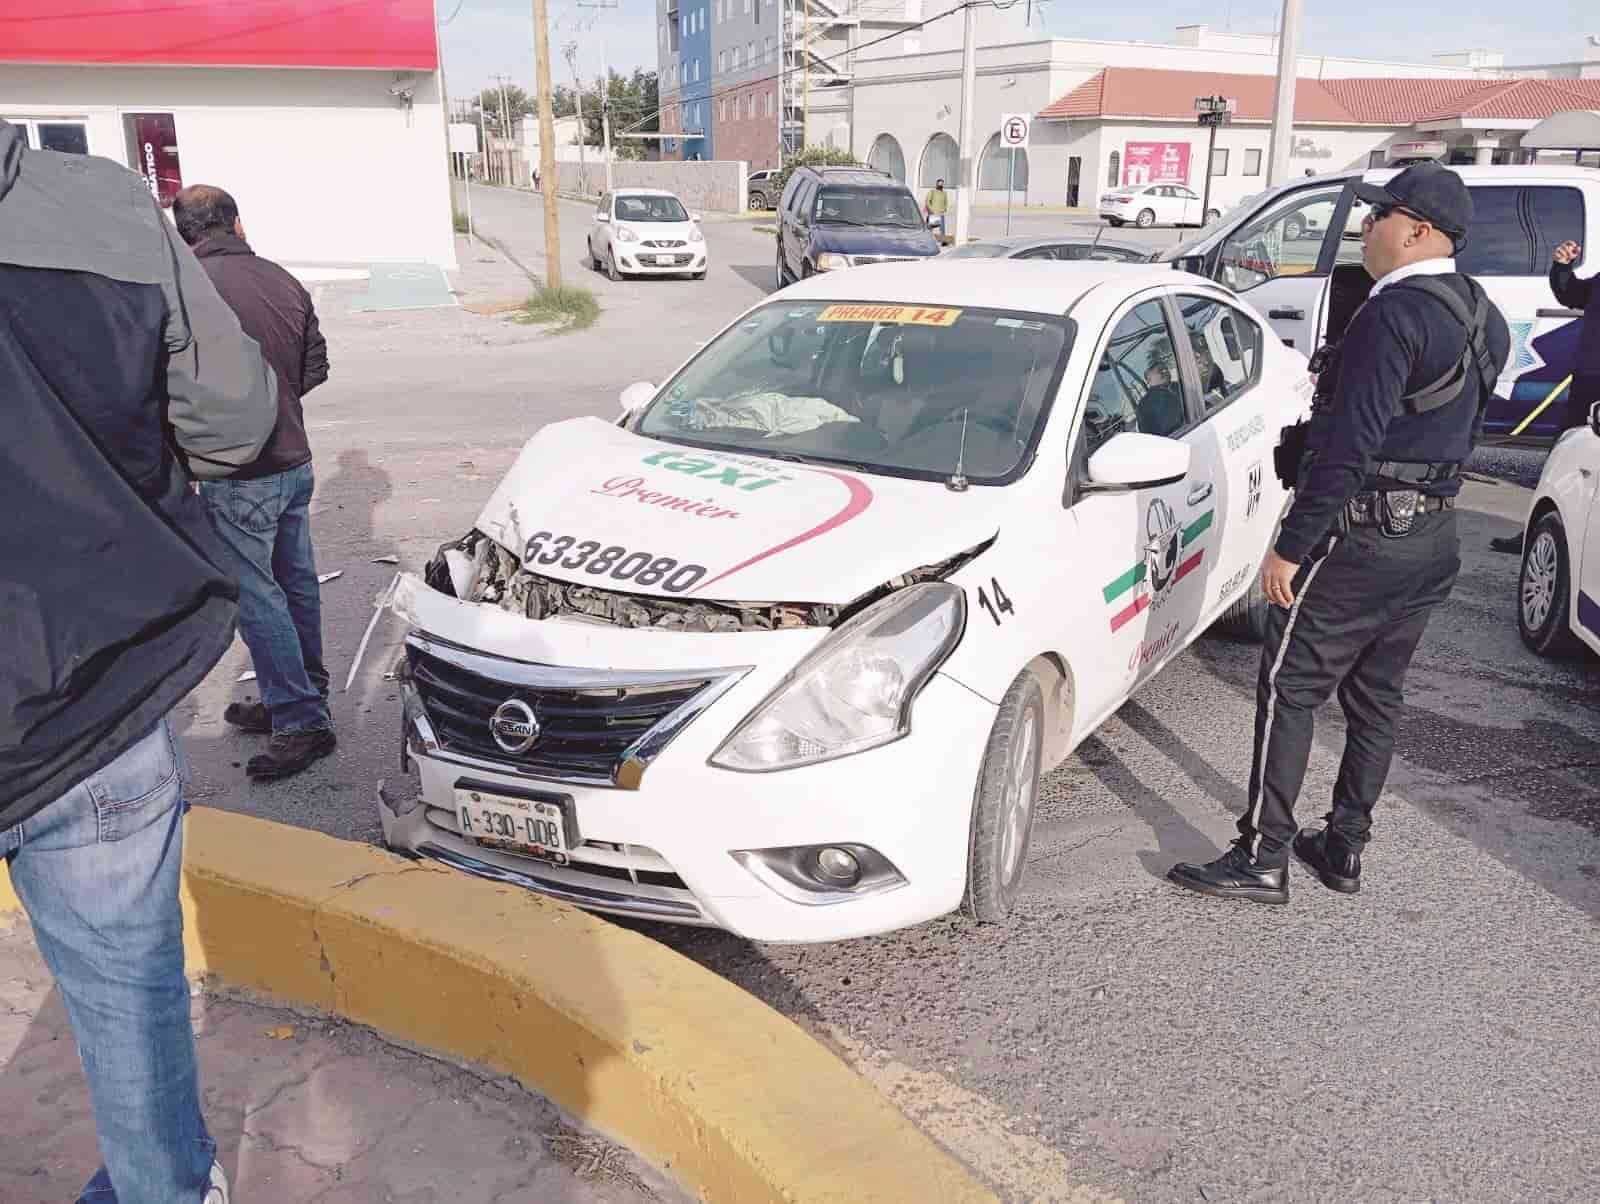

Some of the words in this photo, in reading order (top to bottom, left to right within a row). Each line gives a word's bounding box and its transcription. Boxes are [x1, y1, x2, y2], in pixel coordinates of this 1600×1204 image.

[828, 307, 905, 320] PREMIER
[911, 308, 946, 323] 14
[642, 451, 794, 491] taxi
[591, 475, 742, 519] Premier
[523, 531, 707, 593] 6338080
[978, 576, 1015, 626] 14
[1128, 621, 1179, 672] Premier
